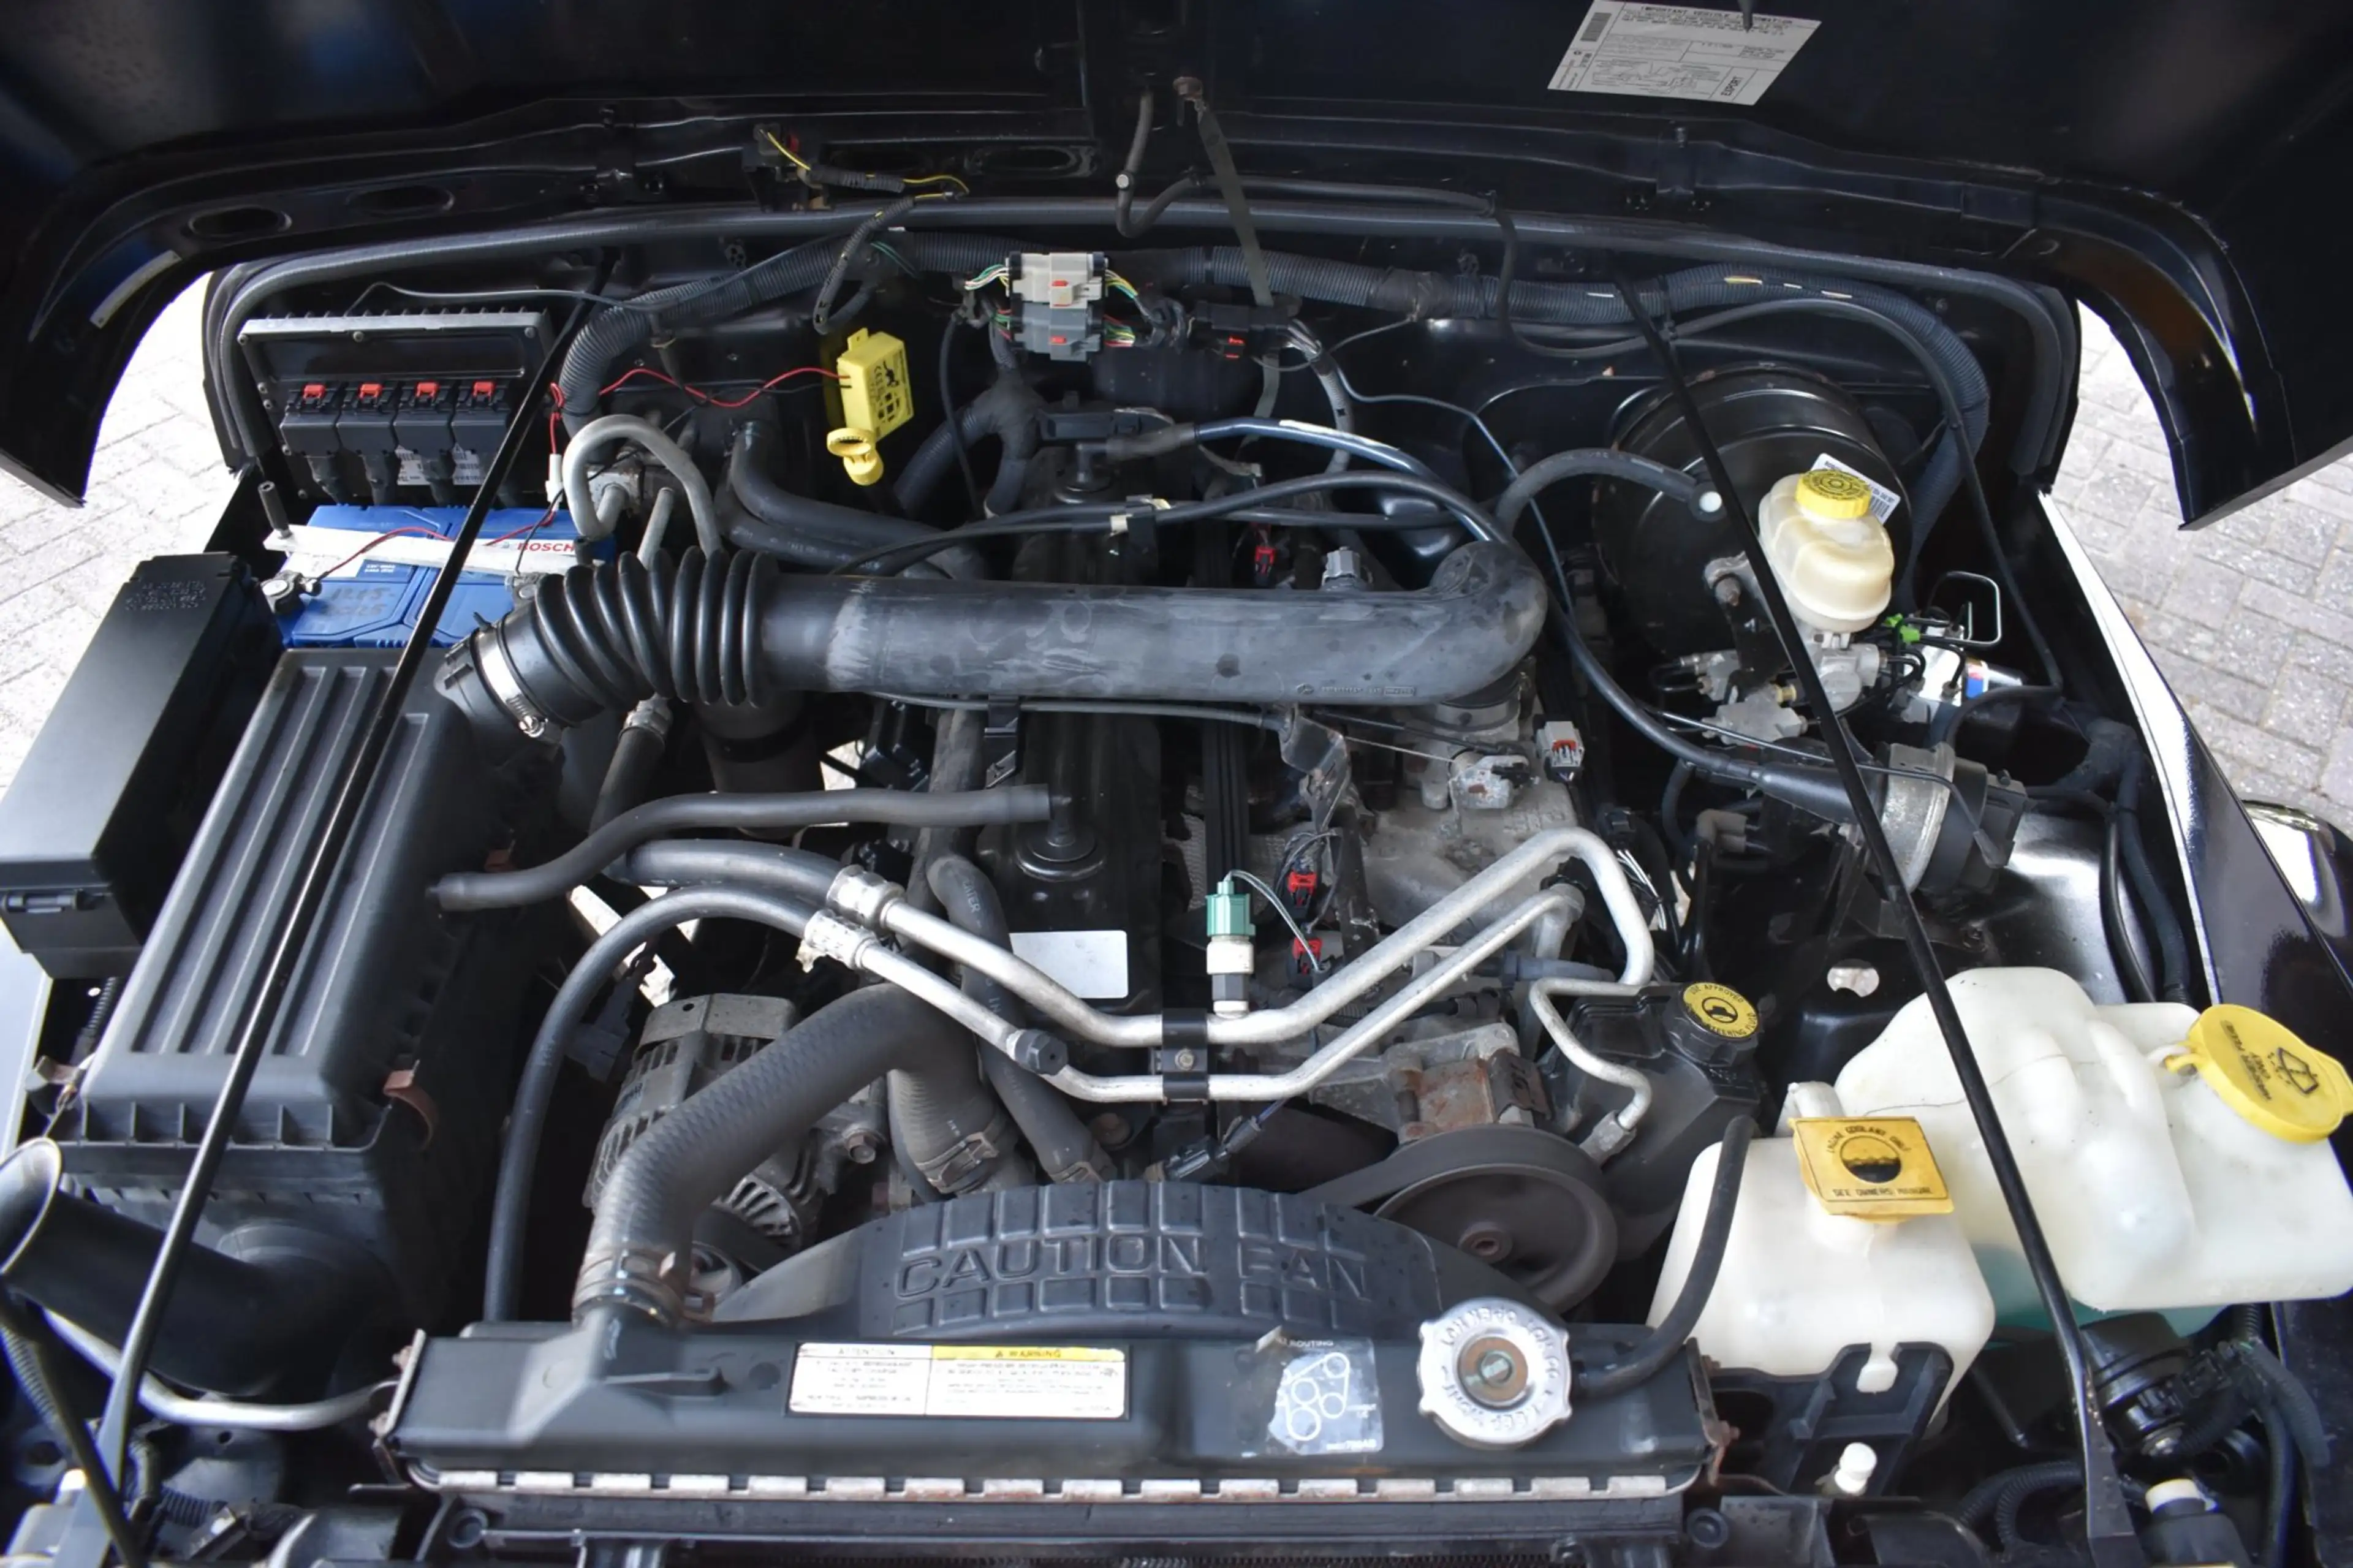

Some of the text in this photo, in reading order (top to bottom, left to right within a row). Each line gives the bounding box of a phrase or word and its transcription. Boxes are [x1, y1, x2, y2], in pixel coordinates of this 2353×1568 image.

[1721, 76, 1745, 96] EXPORT
[895, 1234, 1371, 1301] CAUTION FAN
[1009, 1349, 1062, 1358] WARNING
